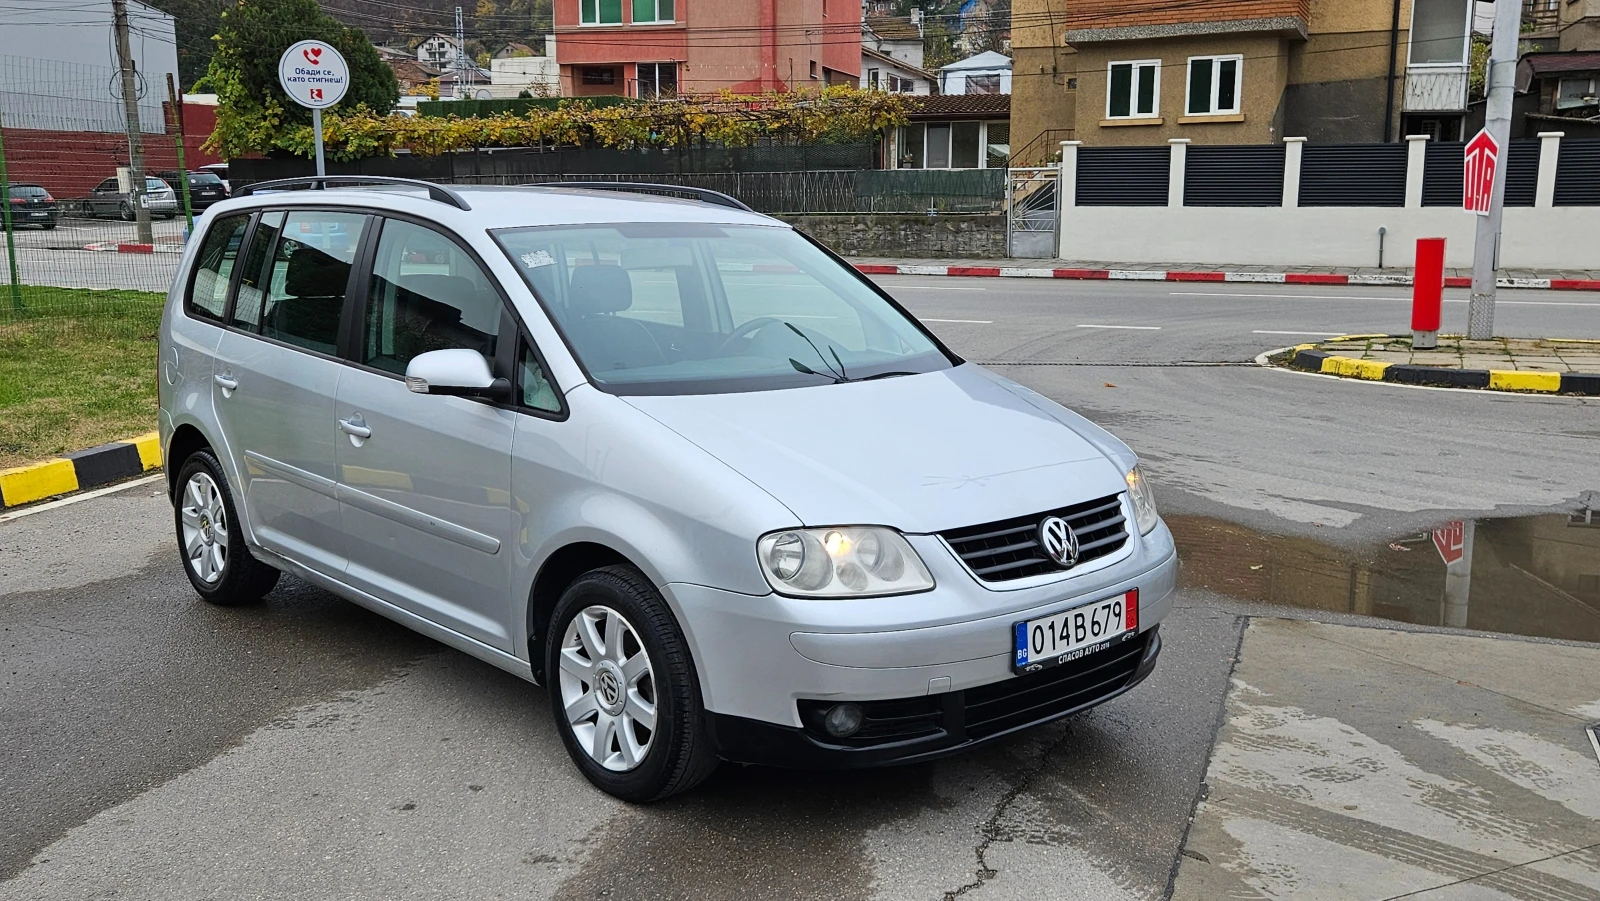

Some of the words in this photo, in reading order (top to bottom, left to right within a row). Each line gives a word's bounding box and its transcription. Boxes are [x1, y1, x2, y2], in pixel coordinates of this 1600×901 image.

[295, 67, 321, 76] Обади
[1032, 601, 1122, 655] 014B679
[1017, 648, 1028, 660] BG
[1058, 649, 1084, 664] СПАСОВ
[1084, 643, 1100, 656] АУТО
